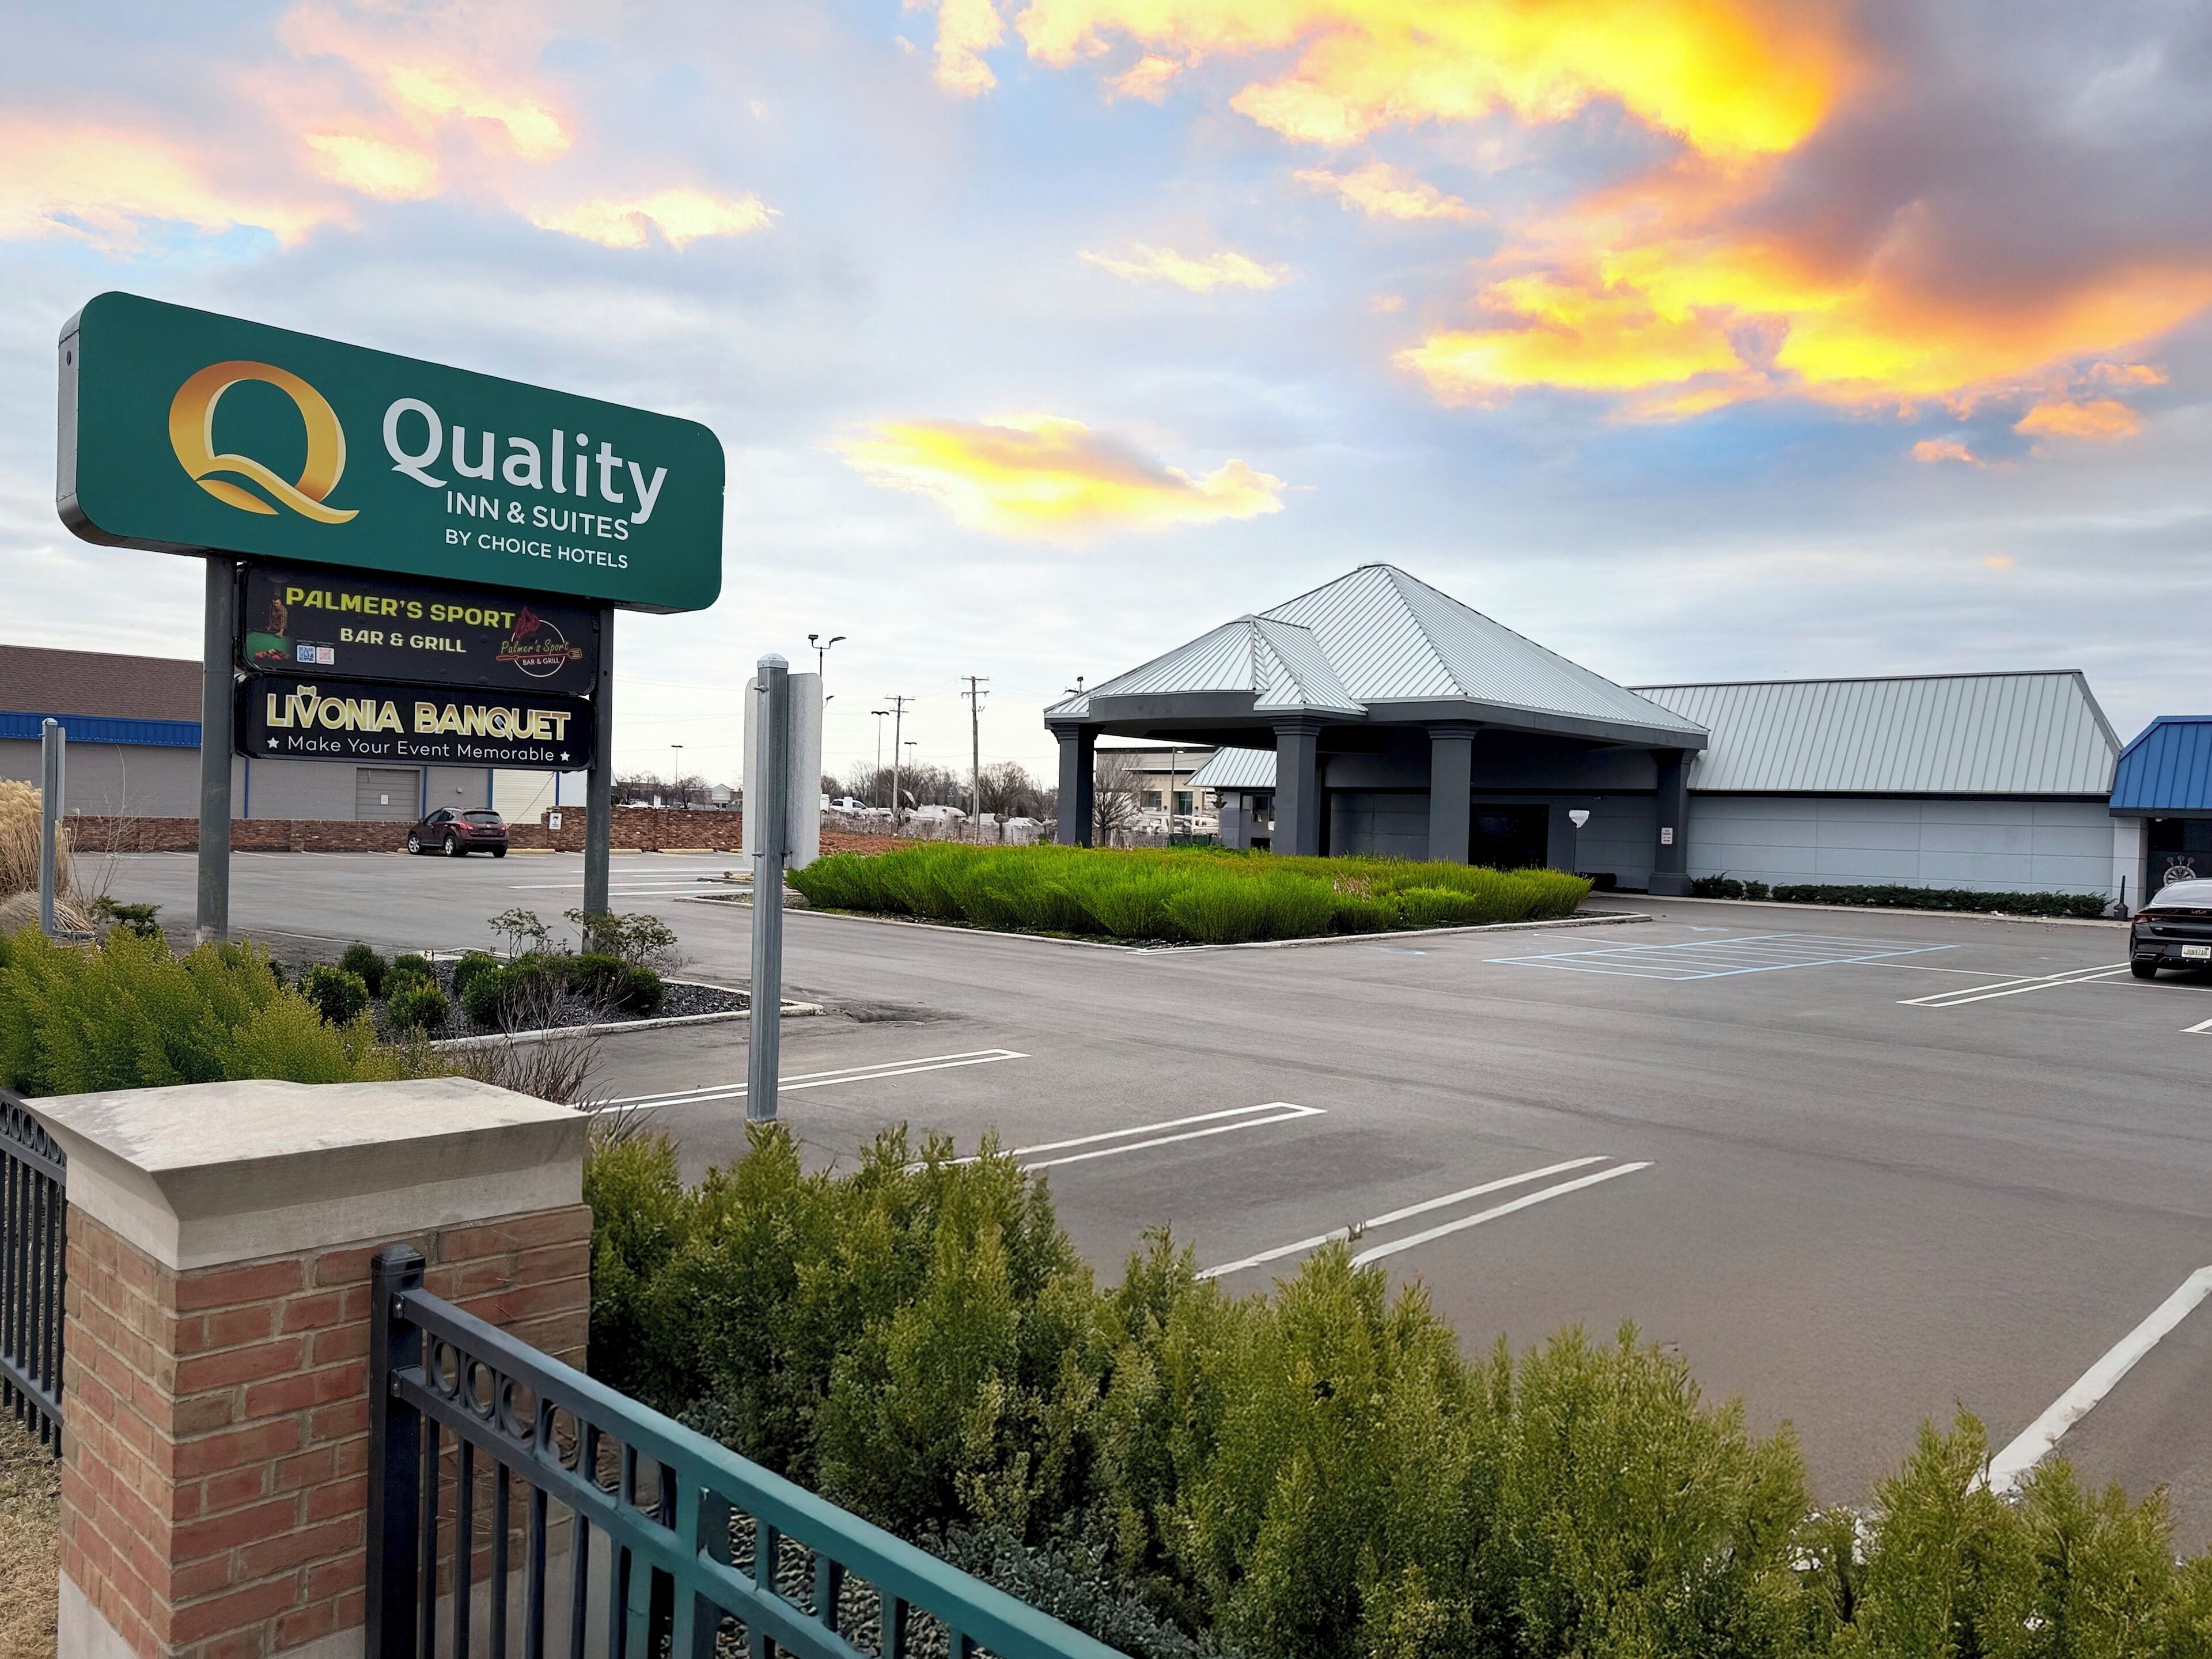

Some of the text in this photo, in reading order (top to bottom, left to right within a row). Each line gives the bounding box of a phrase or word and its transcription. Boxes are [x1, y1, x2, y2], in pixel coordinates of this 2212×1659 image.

[169, 361, 360, 524] Q
[382, 397, 668, 524] Quality
[447, 490, 629, 541] INN & SUITES
[445, 529, 628, 569] BY CHOICE HOTELS
[286, 587, 515, 629] PALMER'S SPORT
[340, 627, 466, 653] BAR & GRILL
[501, 639, 569, 656] Palmer's Sport
[267, 693, 571, 741] LIVONIA BANQUET
[288, 736, 554, 761] Make Your Event Memorable
